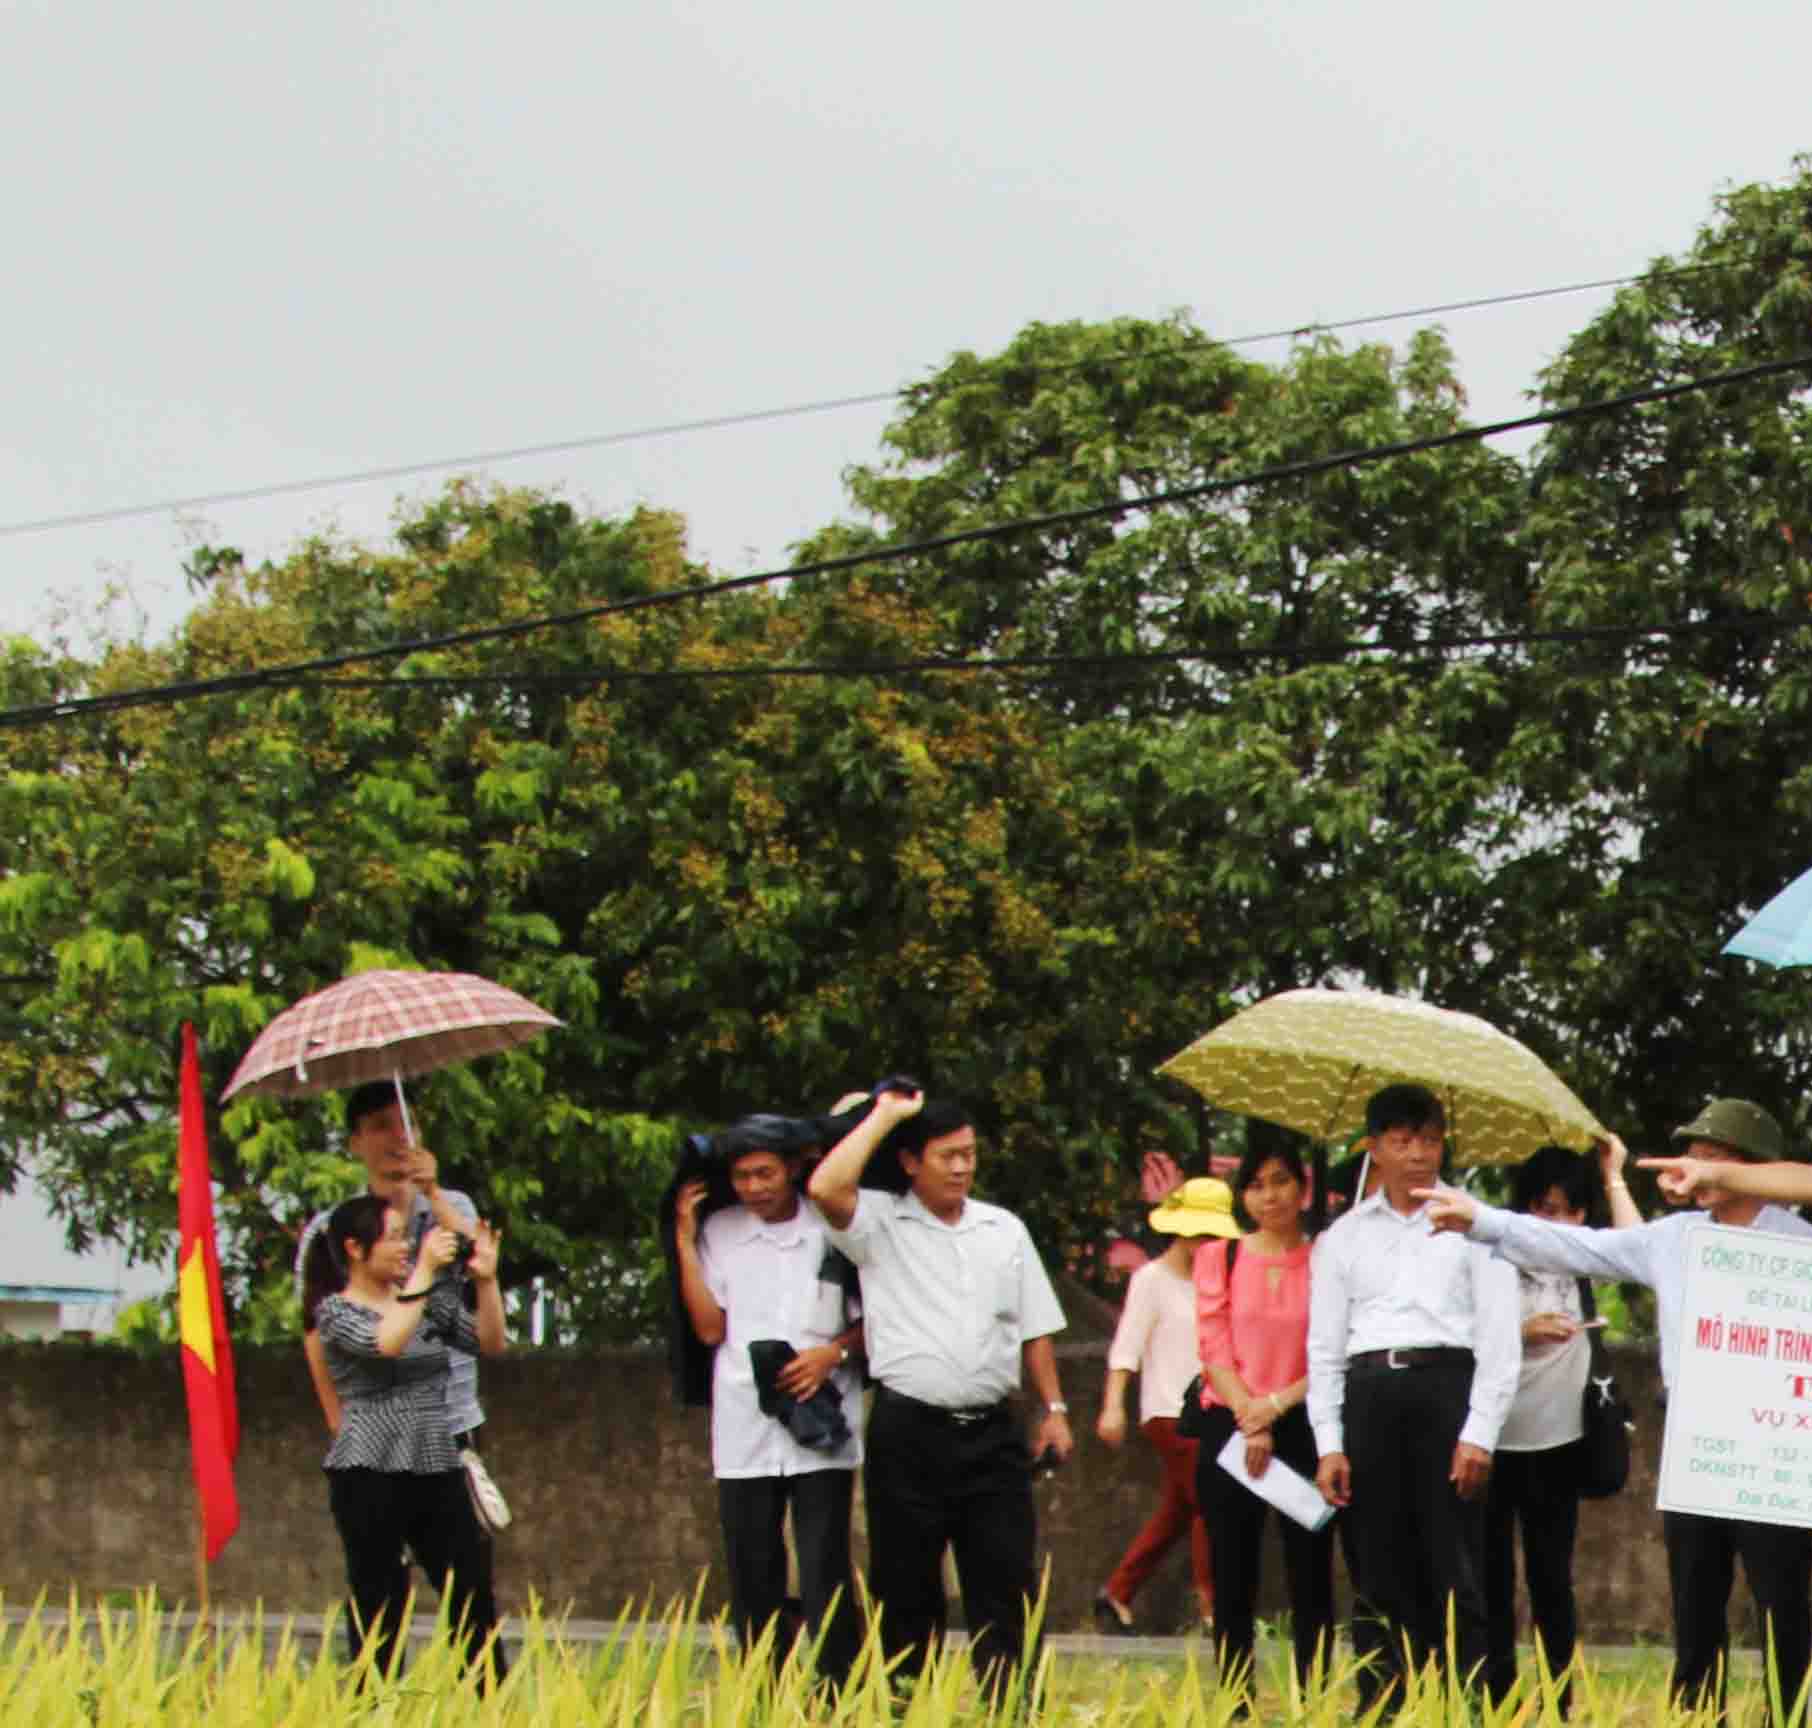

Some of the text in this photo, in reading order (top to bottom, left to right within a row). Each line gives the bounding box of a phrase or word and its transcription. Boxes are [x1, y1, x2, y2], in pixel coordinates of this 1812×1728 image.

[1696, 1312, 1722, 1352] MÔ
[1728, 1316, 1768, 1357] HÌNH
[1751, 1407, 1786, 1430] VỤ
